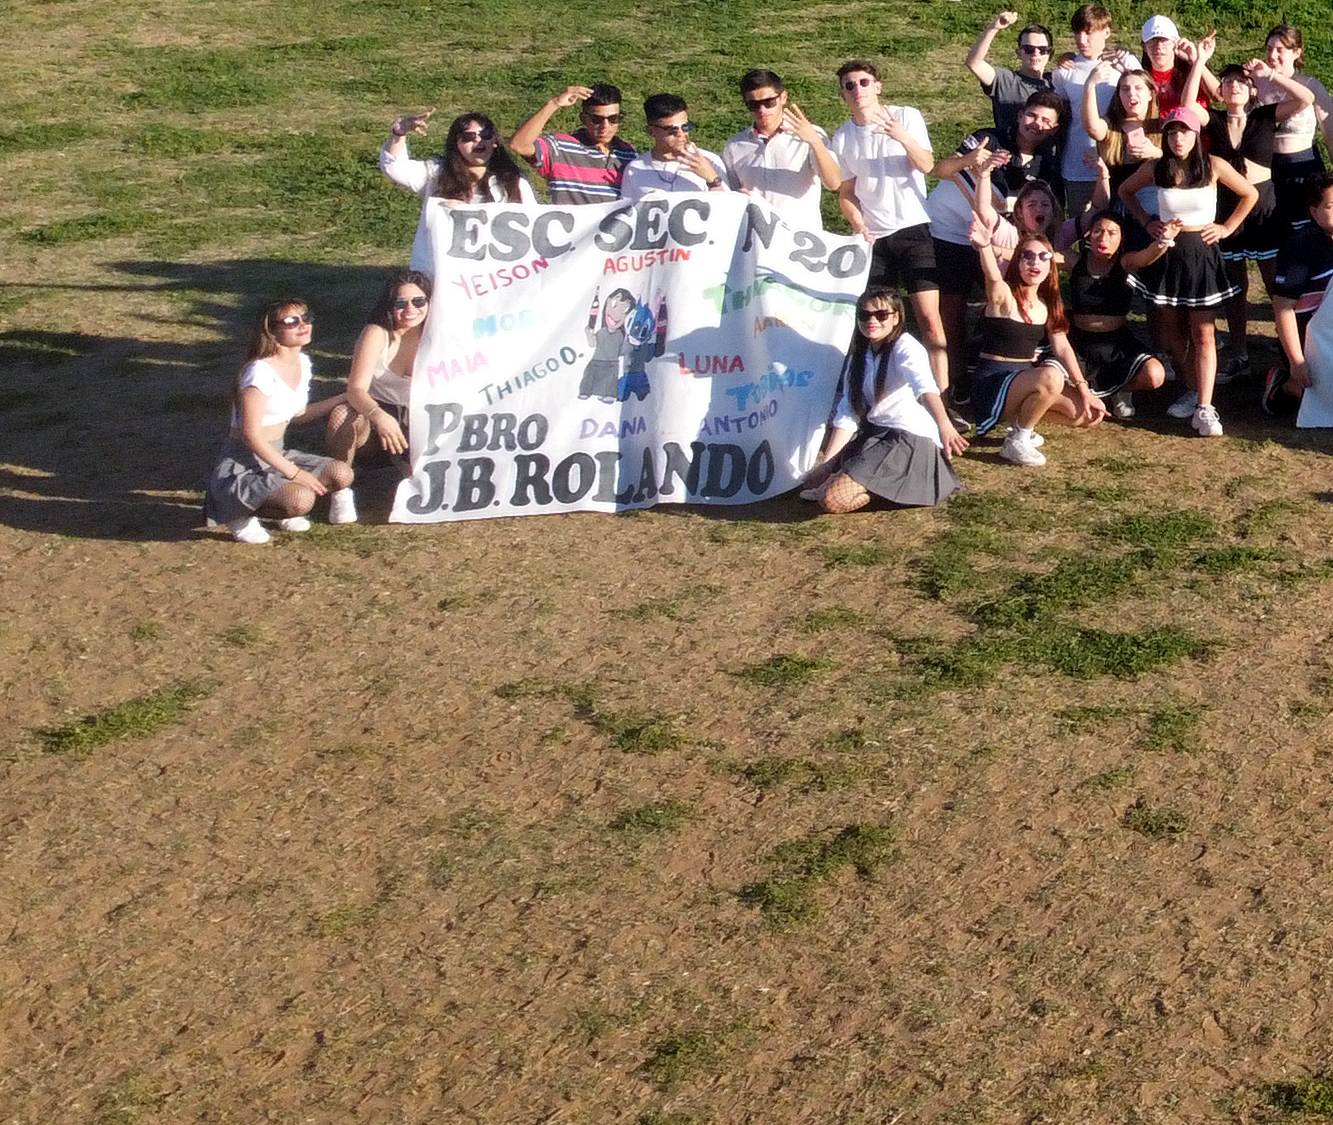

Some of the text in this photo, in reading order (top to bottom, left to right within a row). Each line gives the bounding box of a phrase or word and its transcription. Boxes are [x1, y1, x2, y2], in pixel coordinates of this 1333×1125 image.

[446, 209, 577, 263] ESC.
[594, 199, 715, 252] SEC.
[789, 230, 868, 279] 20
[451, 256, 549, 300] YEISON
[603, 248, 691, 275] AGUSTIN
[425, 351, 489, 389] MAIA
[678, 351, 746, 376] LUNA
[425, 402, 548, 457] PBRO
[579, 417, 647, 441] DANA
